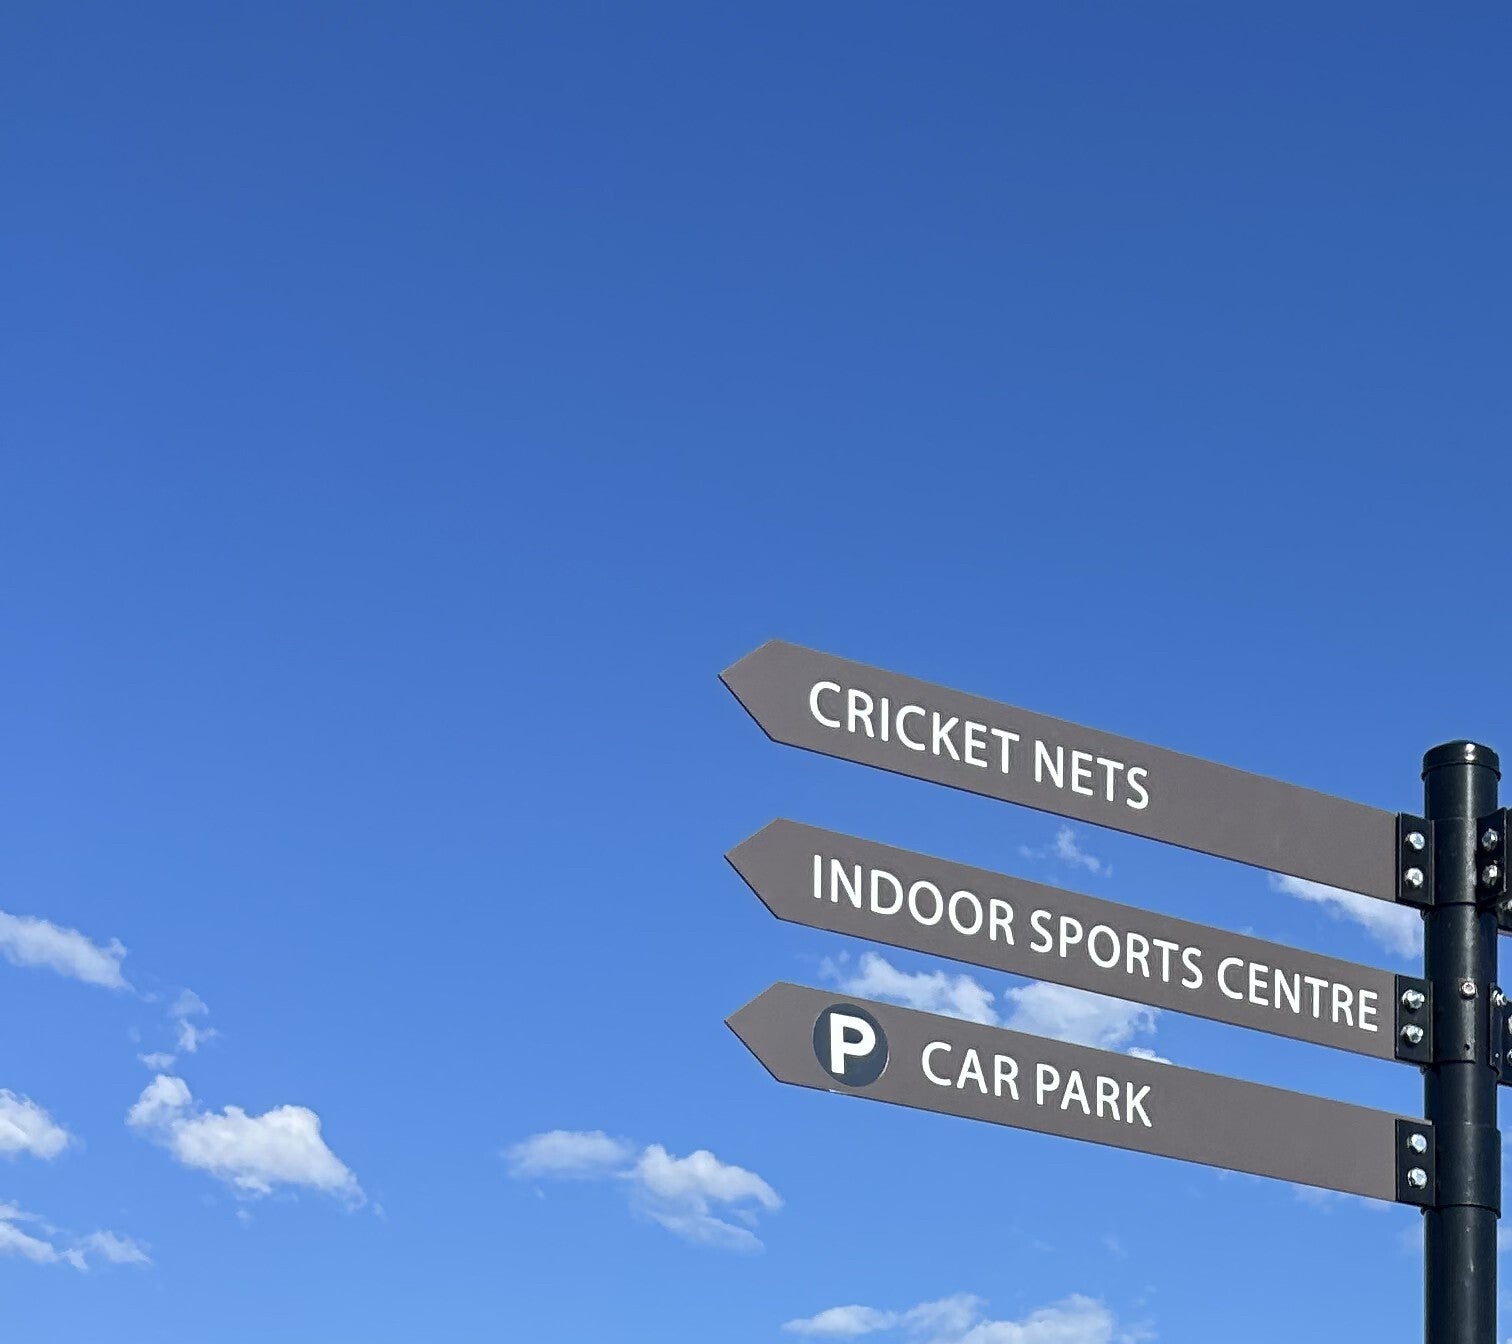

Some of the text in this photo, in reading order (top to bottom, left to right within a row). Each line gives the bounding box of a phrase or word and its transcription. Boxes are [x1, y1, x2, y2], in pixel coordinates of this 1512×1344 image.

[808, 681, 1150, 811] CRICKET NETS
[812, 854, 1379, 1033] INDOOR SPORTS CENTRE
[829, 1012, 876, 1075] P
[920, 1041, 1153, 1128] CAR PARK
